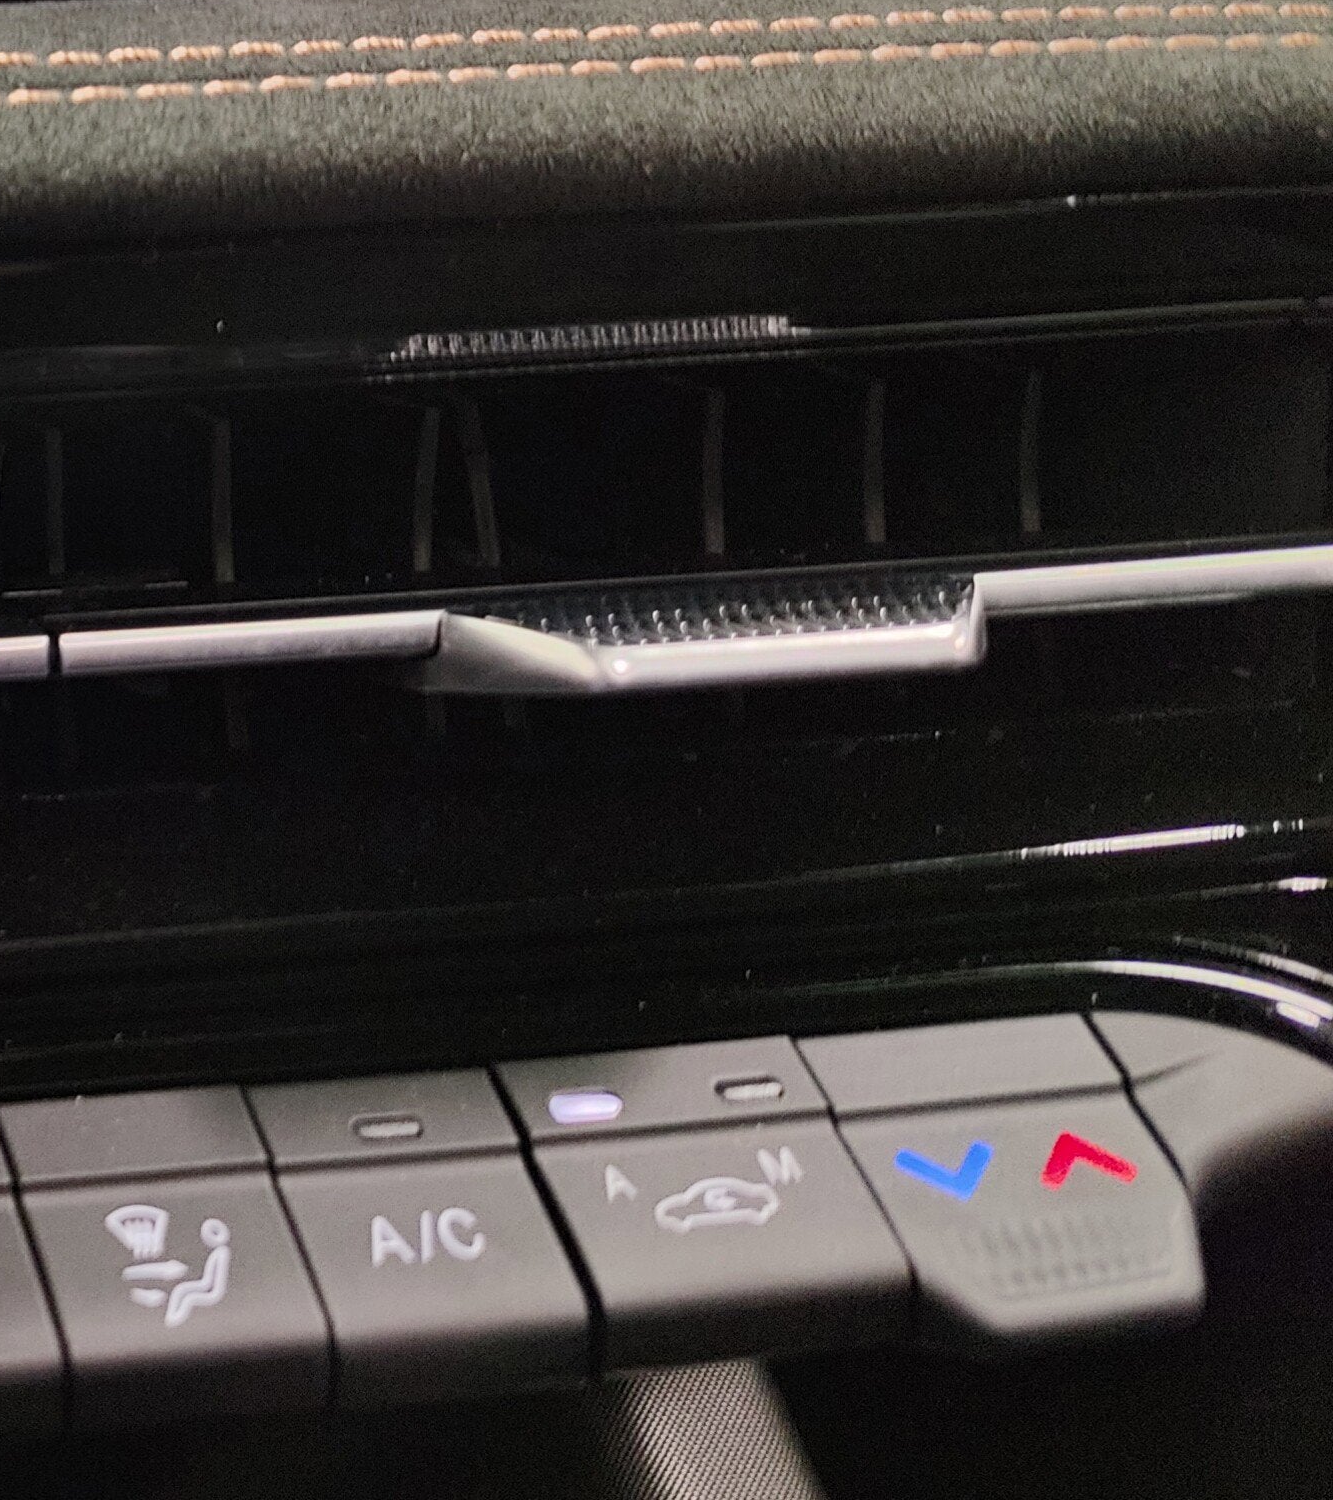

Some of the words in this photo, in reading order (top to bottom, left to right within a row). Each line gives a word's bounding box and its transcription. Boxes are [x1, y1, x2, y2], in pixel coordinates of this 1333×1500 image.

[603, 1164, 637, 1204] A
[757, 1145, 805, 1185] M
[367, 1204, 485, 1268] A/C
